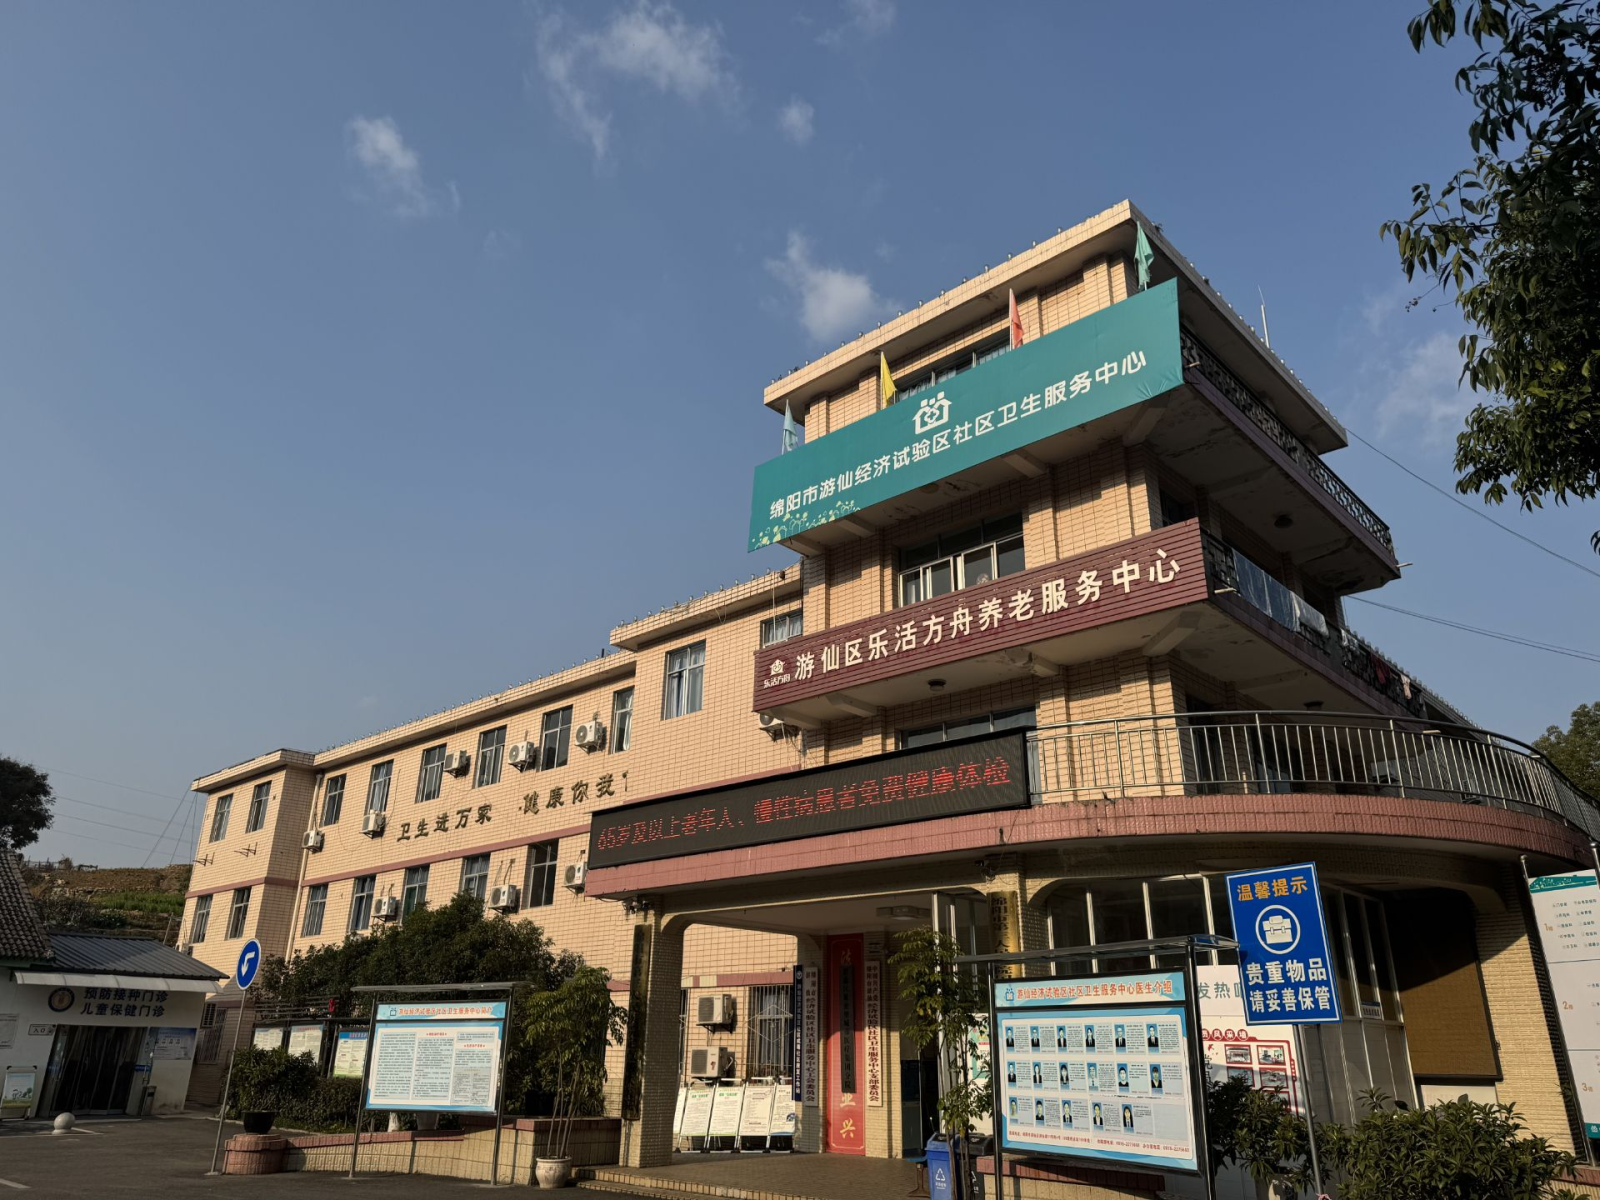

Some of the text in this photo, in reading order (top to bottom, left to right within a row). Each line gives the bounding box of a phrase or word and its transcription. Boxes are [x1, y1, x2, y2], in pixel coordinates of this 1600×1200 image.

[769, 350, 1147, 520] 绵阳市游仙经济试验区社区卫生服务中心
[795, 548, 1180, 680] 游仙区乐活方舟养老服务中心
[397, 803, 493, 842] 卫生进万家
[1237, 876, 1308, 902] 温馨提示
[1246, 957, 1327, 985] 贵重物品
[83, 987, 169, 1002] 预防接种门诊
[1017, 980, 1173, 1000] 游仙经济试验区社区卫生服务中心医生介绍
[1249, 986, 1331, 1013] 请妥善保管
[80, 1002, 165, 1017] 儿童保健门诊
